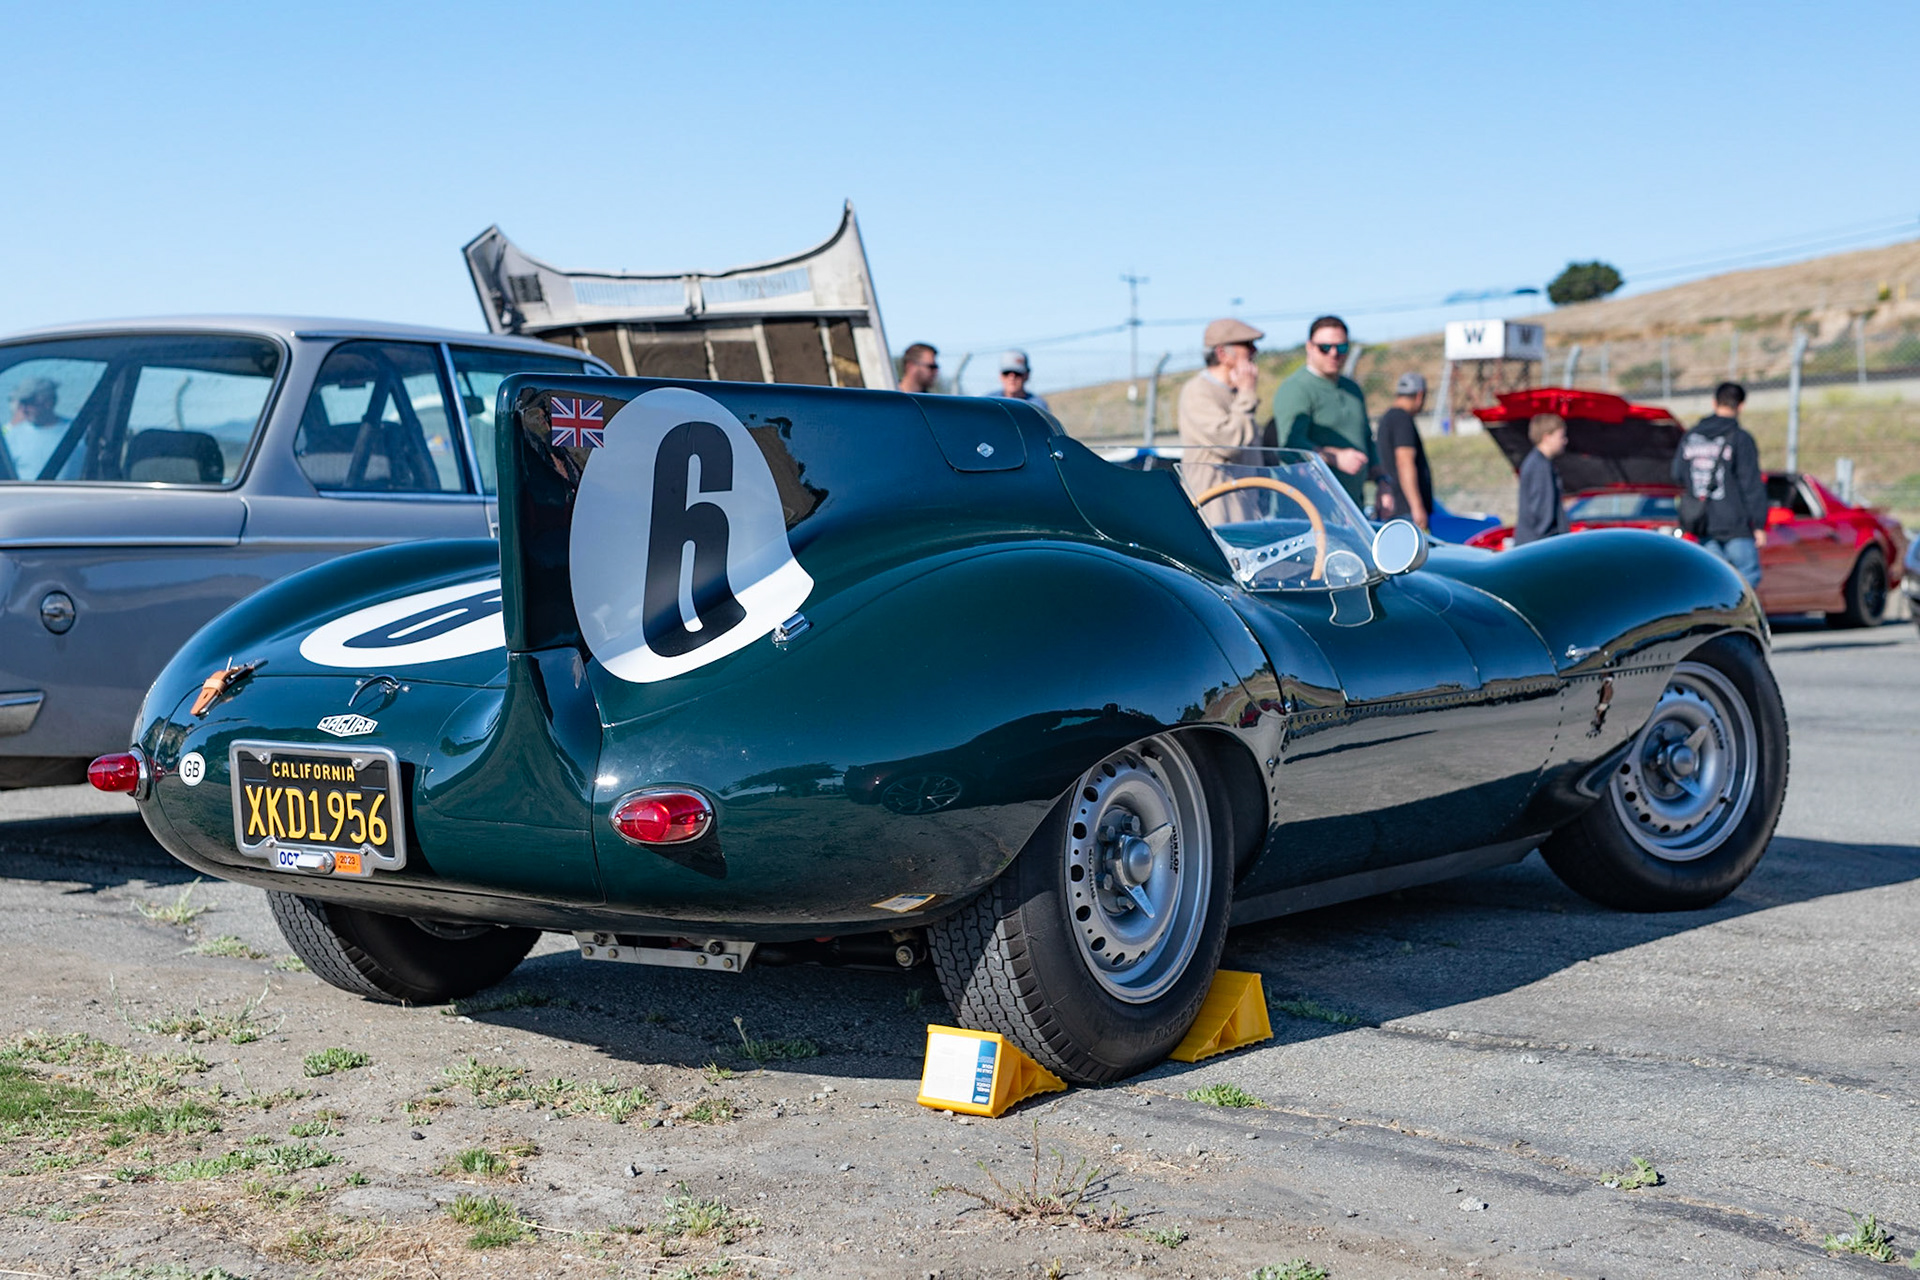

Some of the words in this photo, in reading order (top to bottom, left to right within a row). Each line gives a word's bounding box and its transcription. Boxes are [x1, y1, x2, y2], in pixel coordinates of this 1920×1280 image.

[1464, 326, 1486, 345] W
[642, 421, 747, 658] 6
[318, 715, 376, 735] JAGUAR
[184, 760, 200, 778] GB
[271, 761, 356, 782] CALIFORNIA
[245, 784, 388, 846] XKD1956
[279, 851, 300, 867] OCT
[340, 855, 356, 865] 2023
[1172, 825, 1180, 875] DUNLOP
